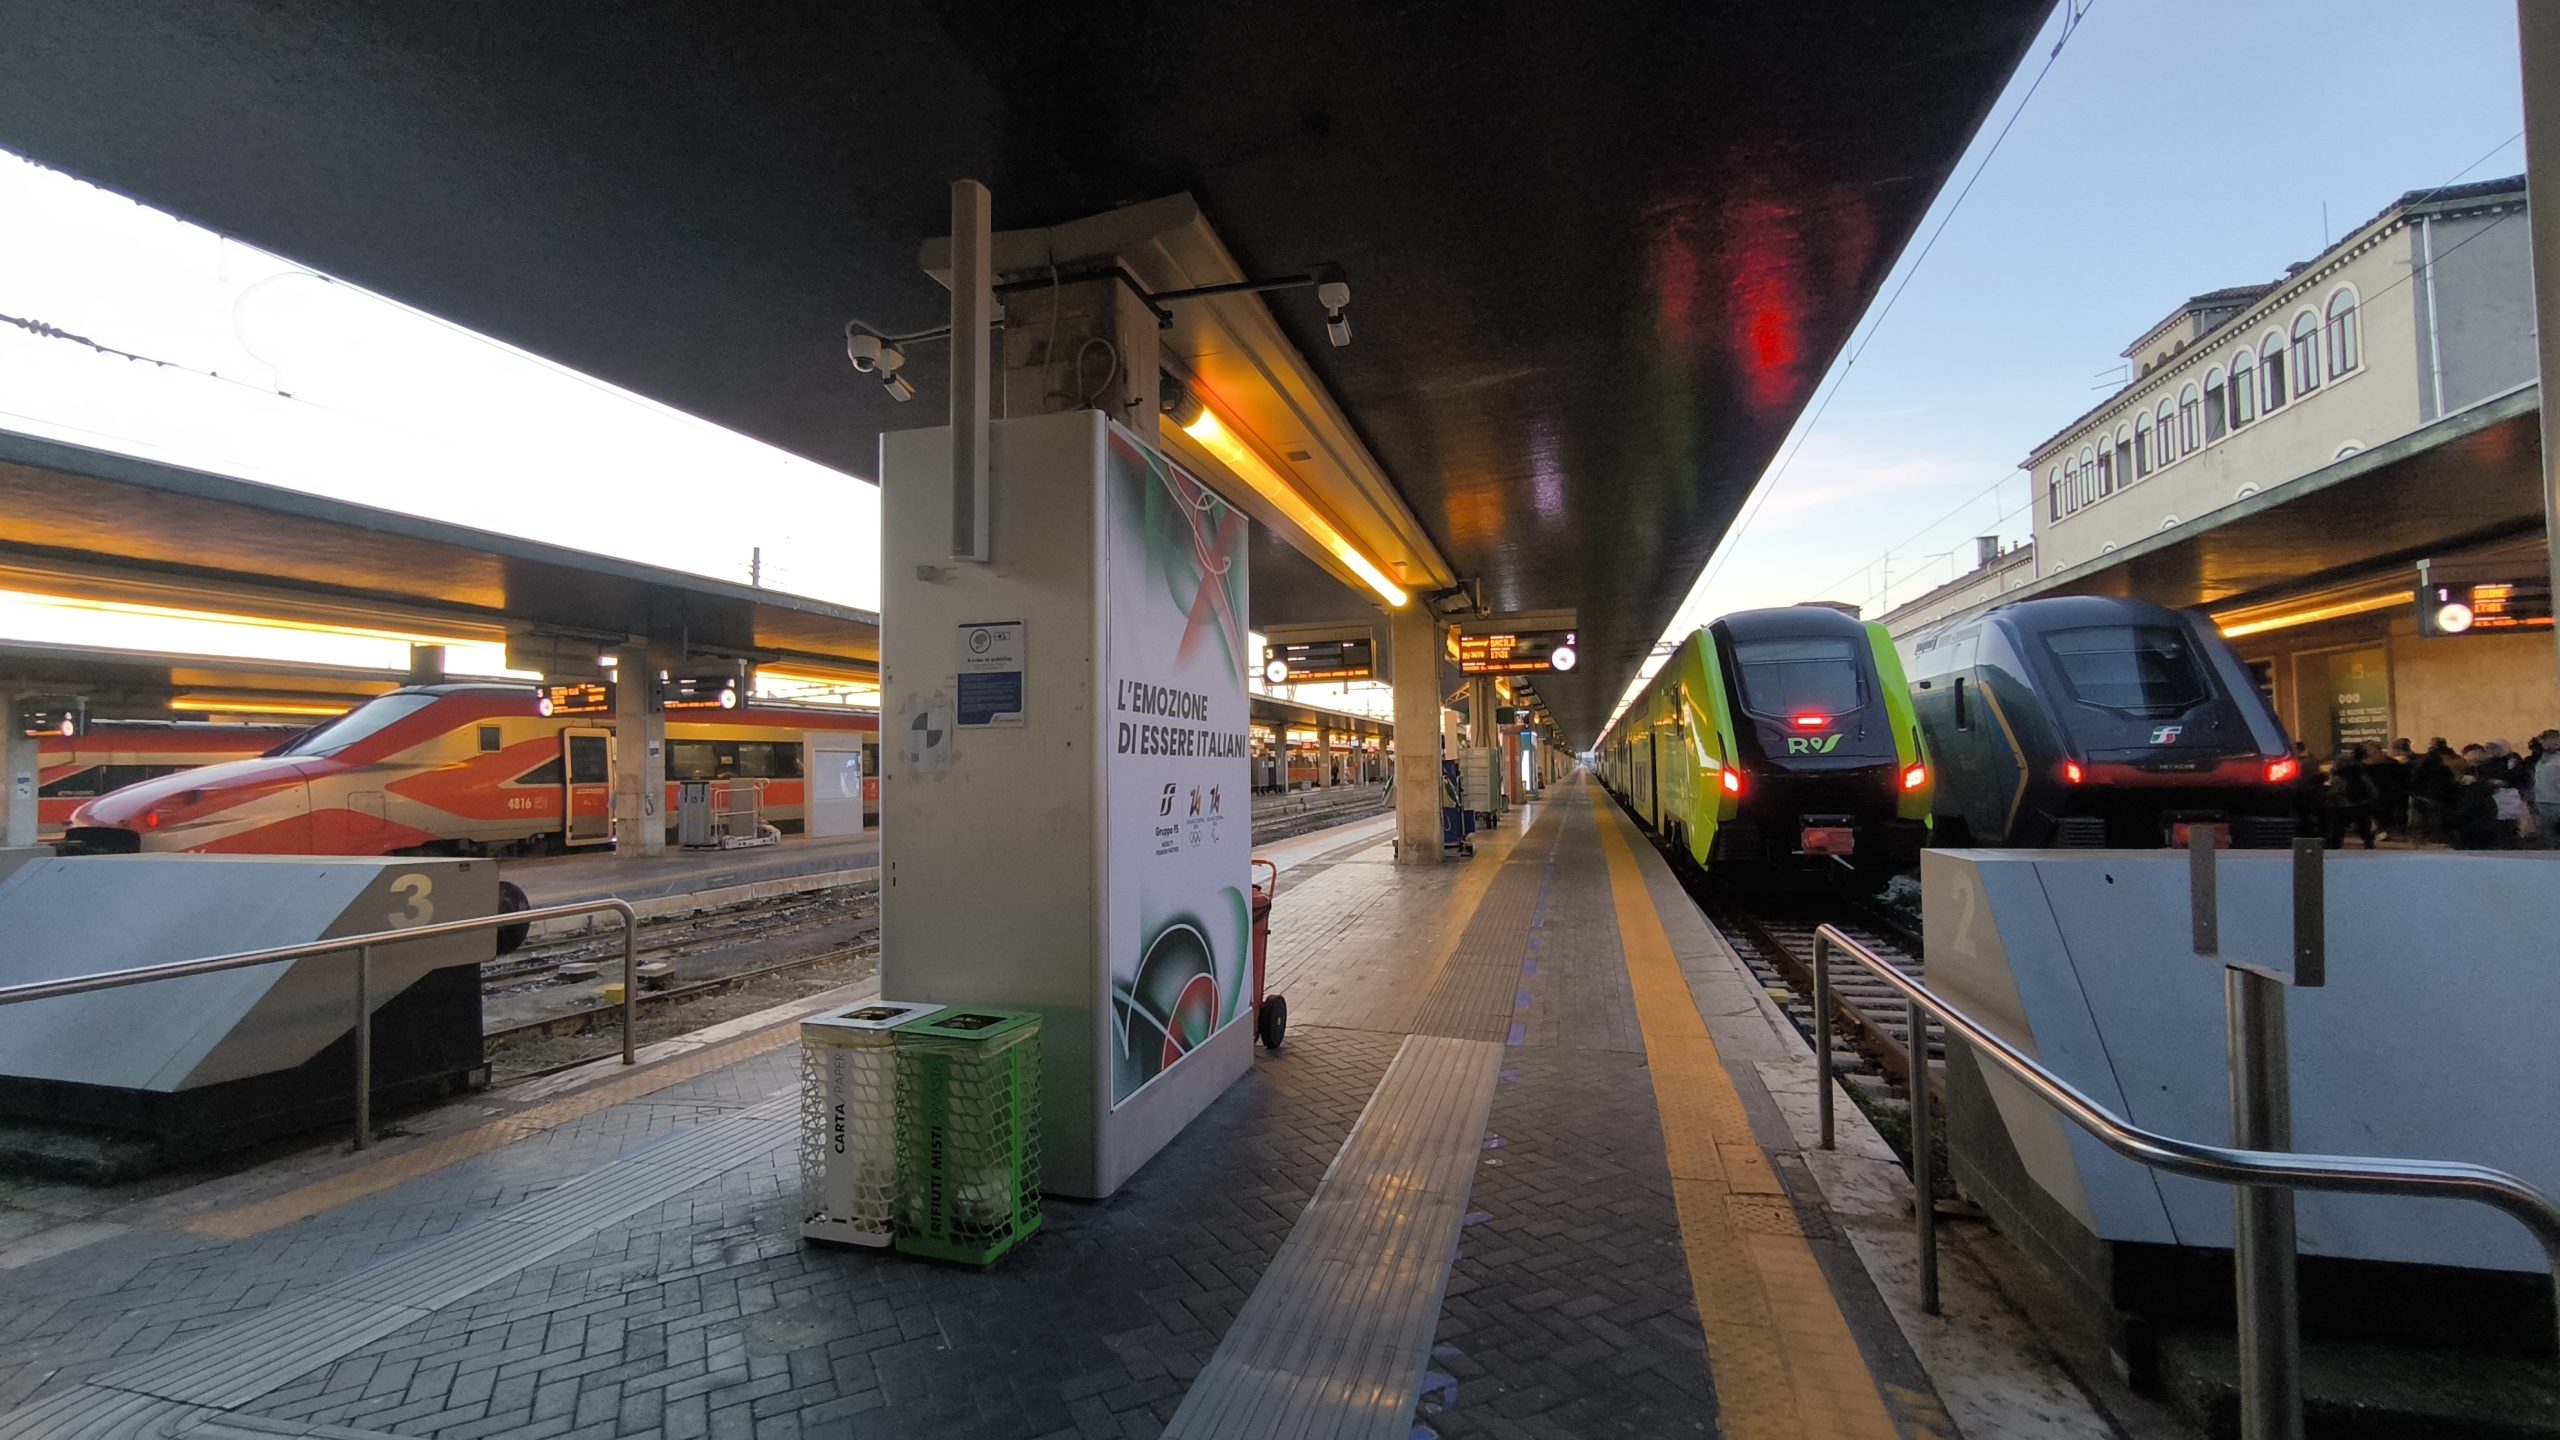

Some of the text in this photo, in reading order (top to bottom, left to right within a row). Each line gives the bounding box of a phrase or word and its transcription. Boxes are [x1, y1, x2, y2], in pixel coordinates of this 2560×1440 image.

[1266, 648, 1274, 659] 3
[1567, 634, 1576, 645] 2
[1118, 679, 1208, 721] L'EMOZIONE
[1118, 722, 1246, 758] DI ESSERE ITALIANI
[507, 797, 533, 810] 4816
[1155, 826, 1174, 837] Gruppo
[388, 873, 434, 930] 3
[1951, 870, 1976, 958] 2
[931, 1176, 943, 1234] RIFIUTI
